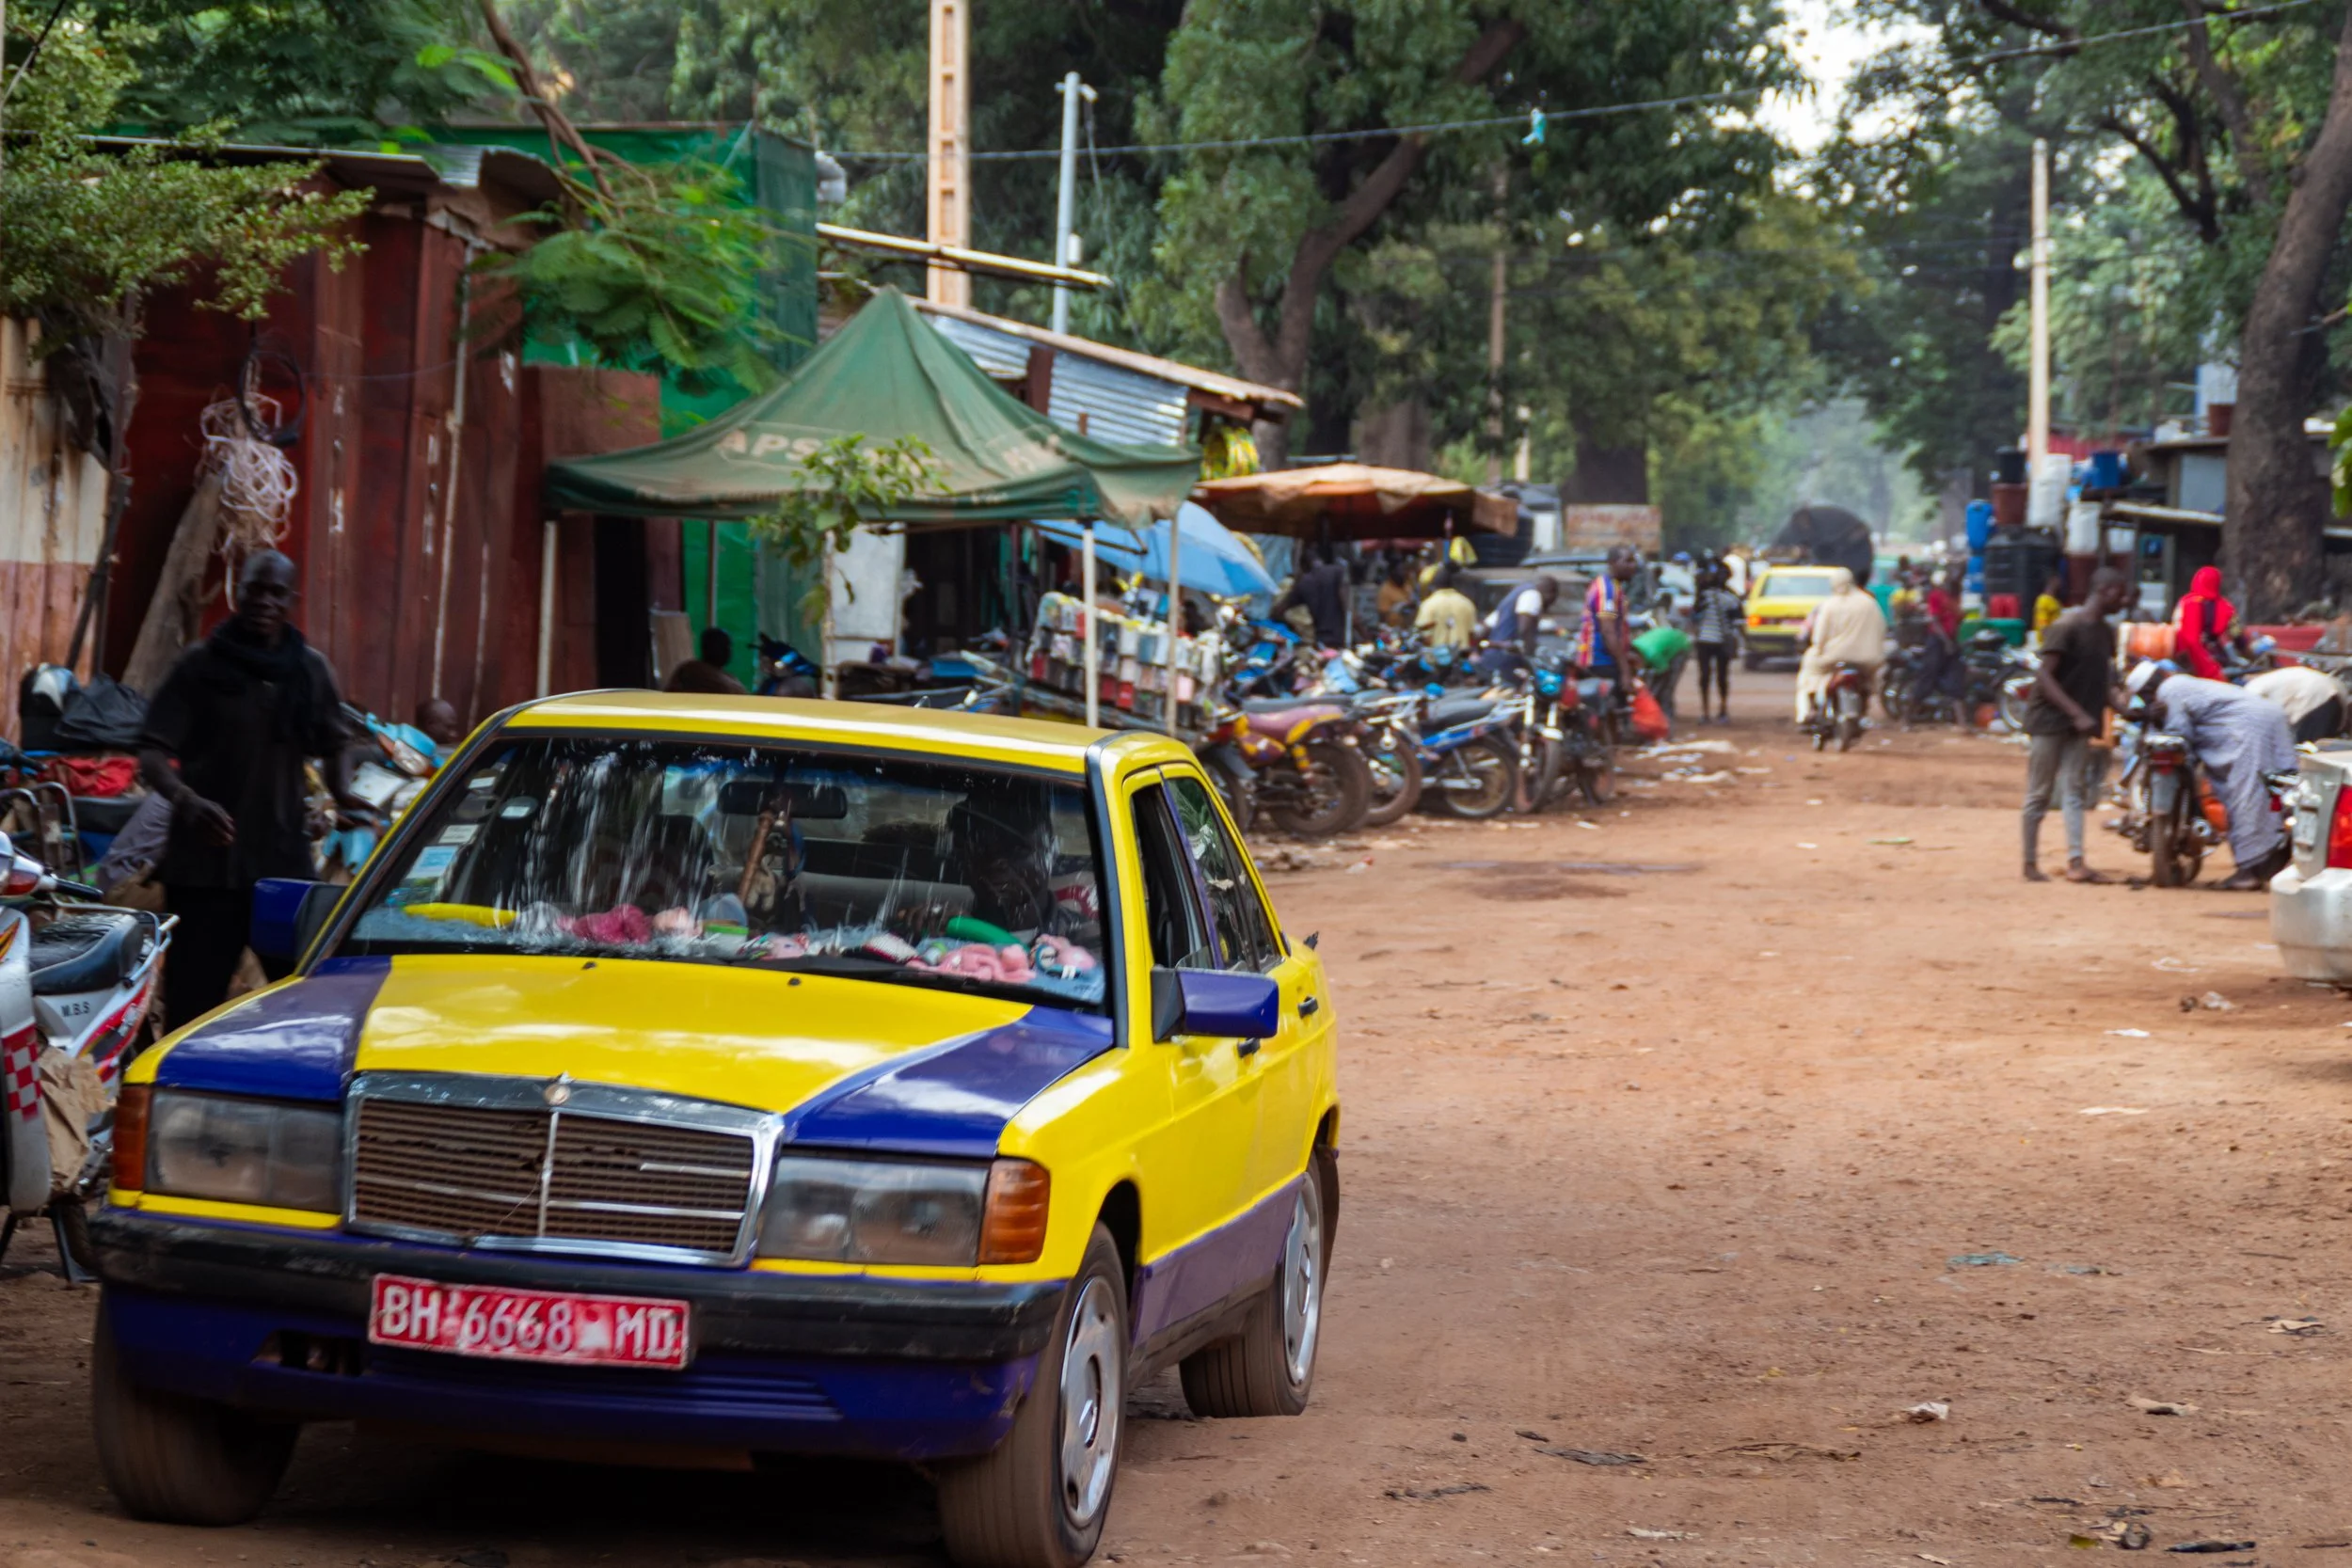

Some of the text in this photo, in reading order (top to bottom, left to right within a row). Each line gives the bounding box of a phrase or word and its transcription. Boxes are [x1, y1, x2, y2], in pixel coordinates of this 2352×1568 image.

[381, 1284, 677, 1361] BH 6668 MD
